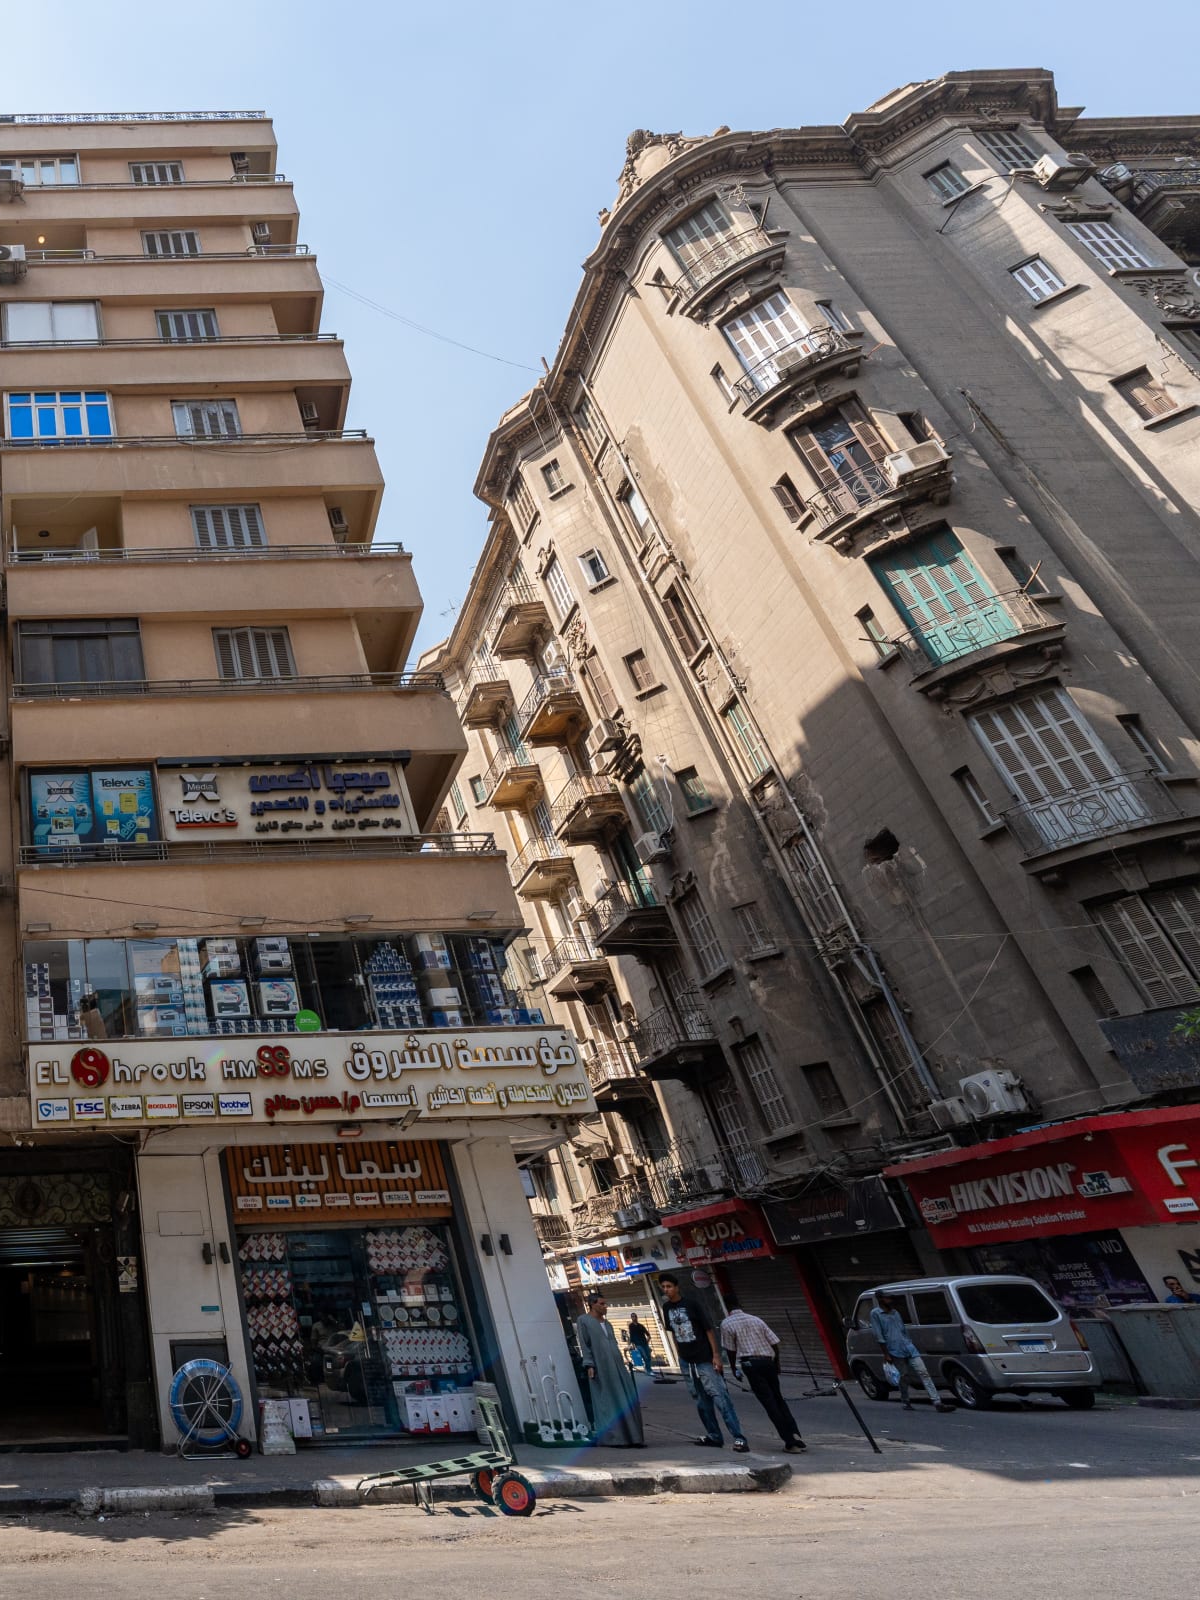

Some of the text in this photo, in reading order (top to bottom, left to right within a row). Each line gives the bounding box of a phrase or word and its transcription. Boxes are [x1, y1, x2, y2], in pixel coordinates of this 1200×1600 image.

[187, 783, 214, 792] Media
[249, 766, 390, 794] ميديا اكس
[314, 799, 326, 814] و
[345, 1034, 577, 1081] مؤسسة الشروق
[36, 1060, 69, 1086] EL
[219, 1100, 250, 1109] brother
[362, 1084, 418, 1107] أسسها
[428, 1081, 589, 1111] للحلول المتكاملة و أنظمة الكاشير
[75, 1102, 104, 1112] TSC
[120, 1103, 141, 1111] ZEBRA
[184, 1101, 213, 1110] EPSON
[243, 1153, 422, 1190] سما لينك
[951, 1163, 1075, 1213] HIKVISION
[1008, 1216, 1034, 1228] Security
[1056, 1209, 1086, 1222] Provider
[1097, 1239, 1124, 1254] WD
